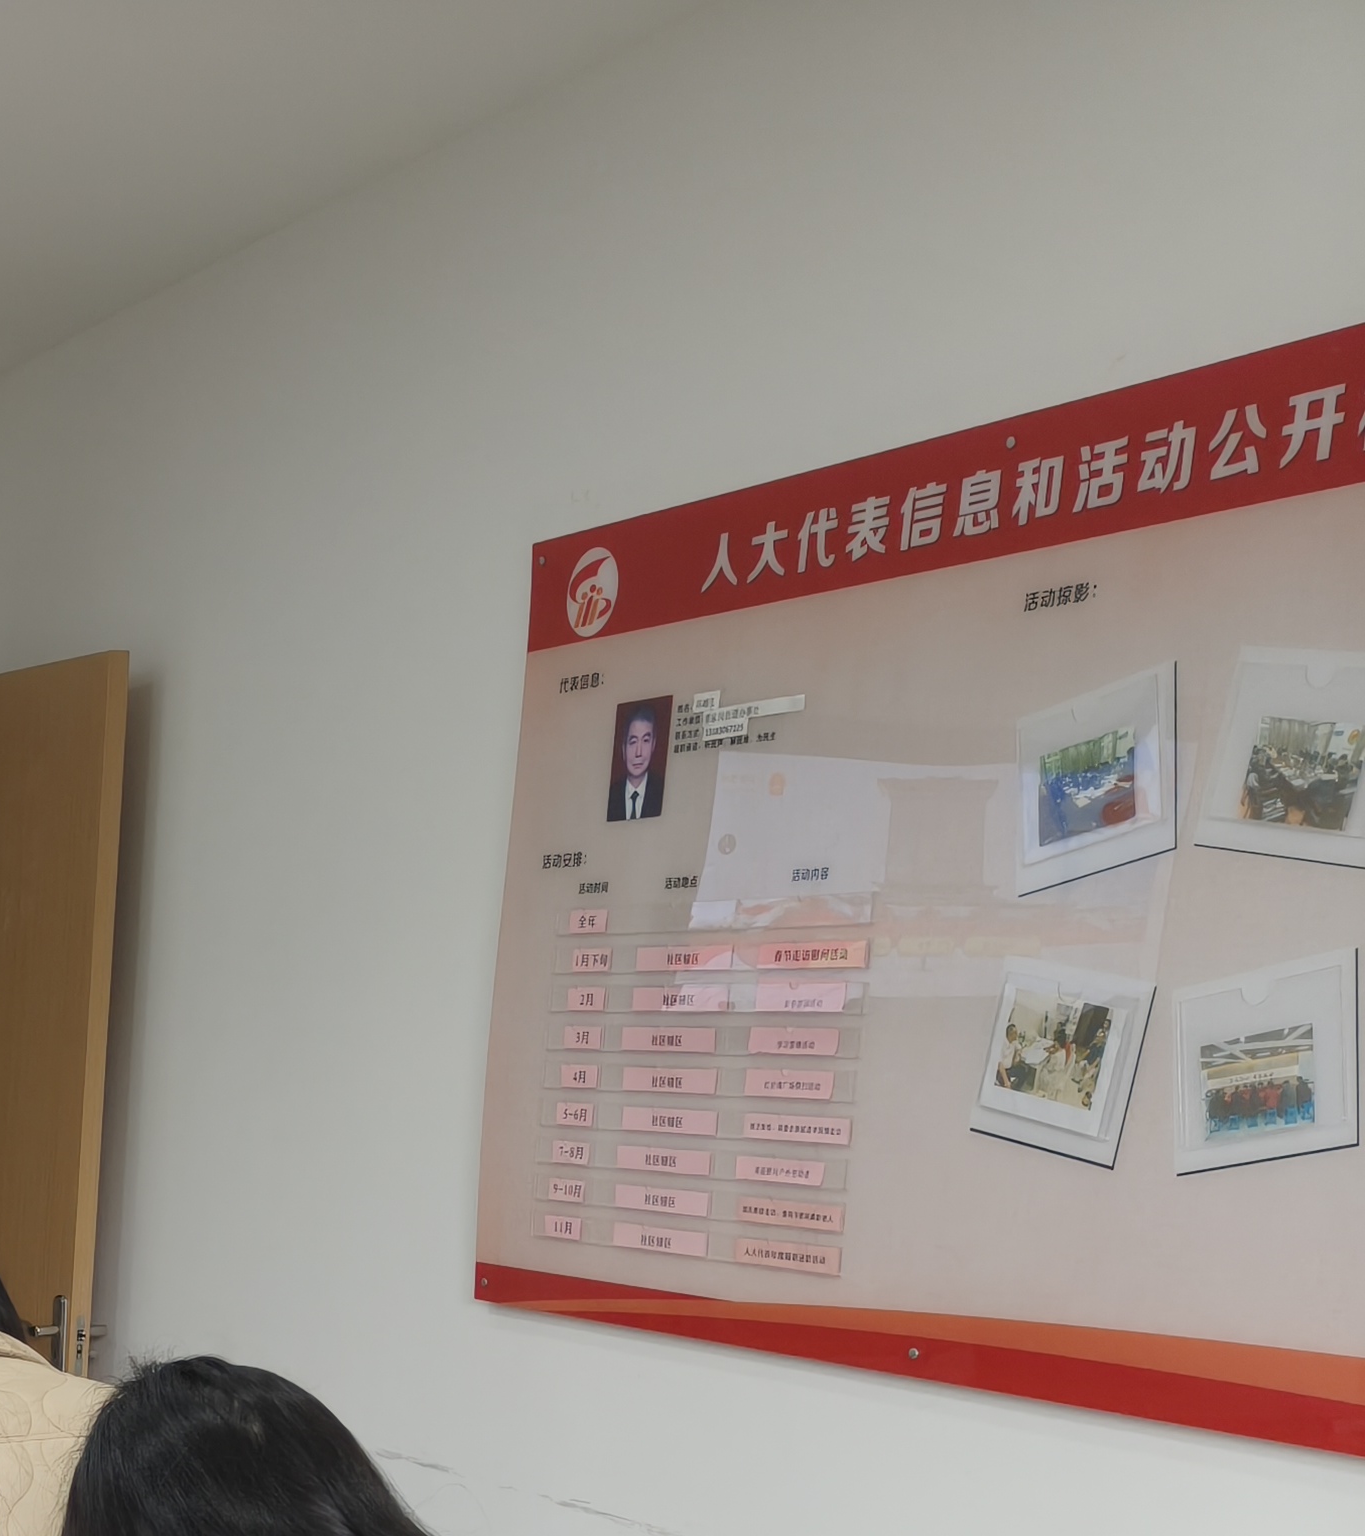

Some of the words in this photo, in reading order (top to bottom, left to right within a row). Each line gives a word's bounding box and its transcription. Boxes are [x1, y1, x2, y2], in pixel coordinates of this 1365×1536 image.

[701, 383, 1365, 592] 人大代表信息和活动公开
[791, 867, 829, 882] 活动内容
[664, 875, 699, 890] 活动地点
[578, 915, 597, 929] 全年
[579, 993, 594, 1007] 2月
[575, 1031, 590, 1045] 3月
[573, 1070, 586, 1084] 4月
[563, 1108, 587, 1122] 5-6月
[558, 1146, 584, 1160] 7-8月
[553, 1183, 582, 1198] 9-10月
[554, 1221, 572, 1235] 11月
